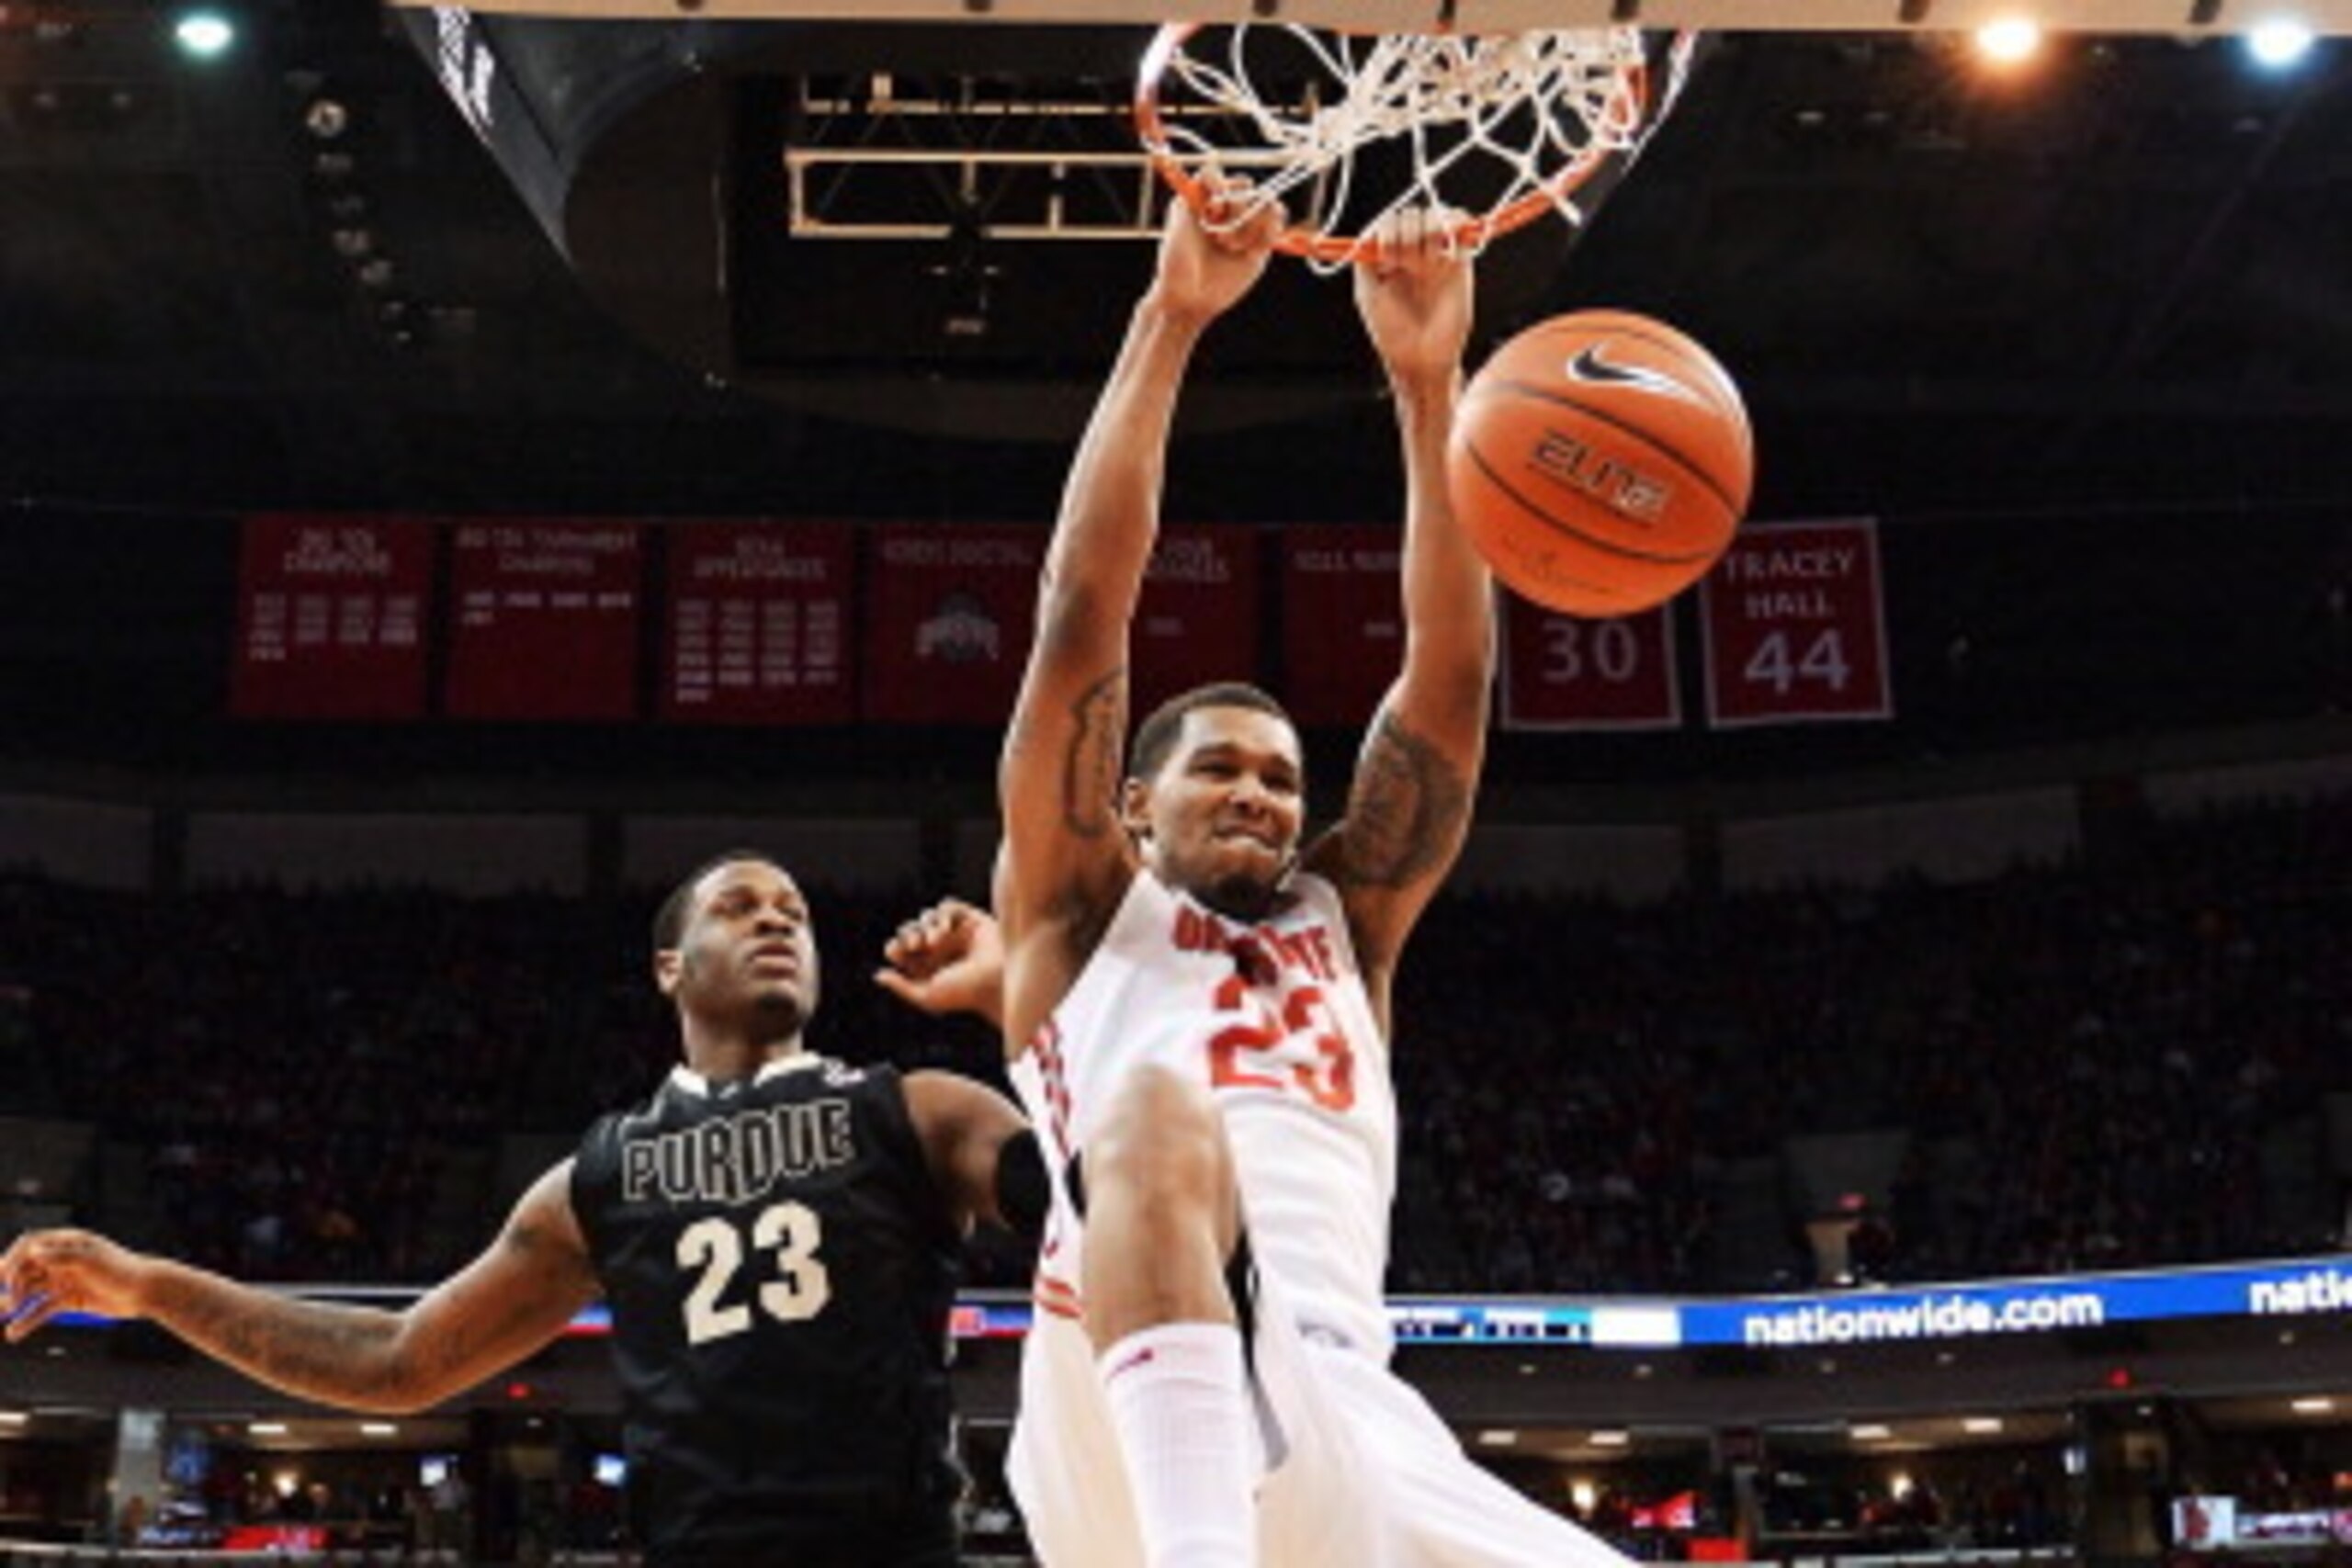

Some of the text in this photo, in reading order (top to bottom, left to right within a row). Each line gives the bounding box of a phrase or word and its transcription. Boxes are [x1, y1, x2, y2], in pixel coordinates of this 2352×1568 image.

[1532, 429, 1668, 523] ELITE
[1724, 547, 1856, 584] TRACEY
[1746, 590, 1837, 621] HALL
[1542, 619, 1638, 682] 30
[1744, 629, 1852, 695] 44
[1208, 976, 1355, 1112] 23
[623, 1099, 854, 1205] PURDUE
[676, 1201, 831, 1345] 23
[1744, 1294, 2102, 1346] nationwide.com
